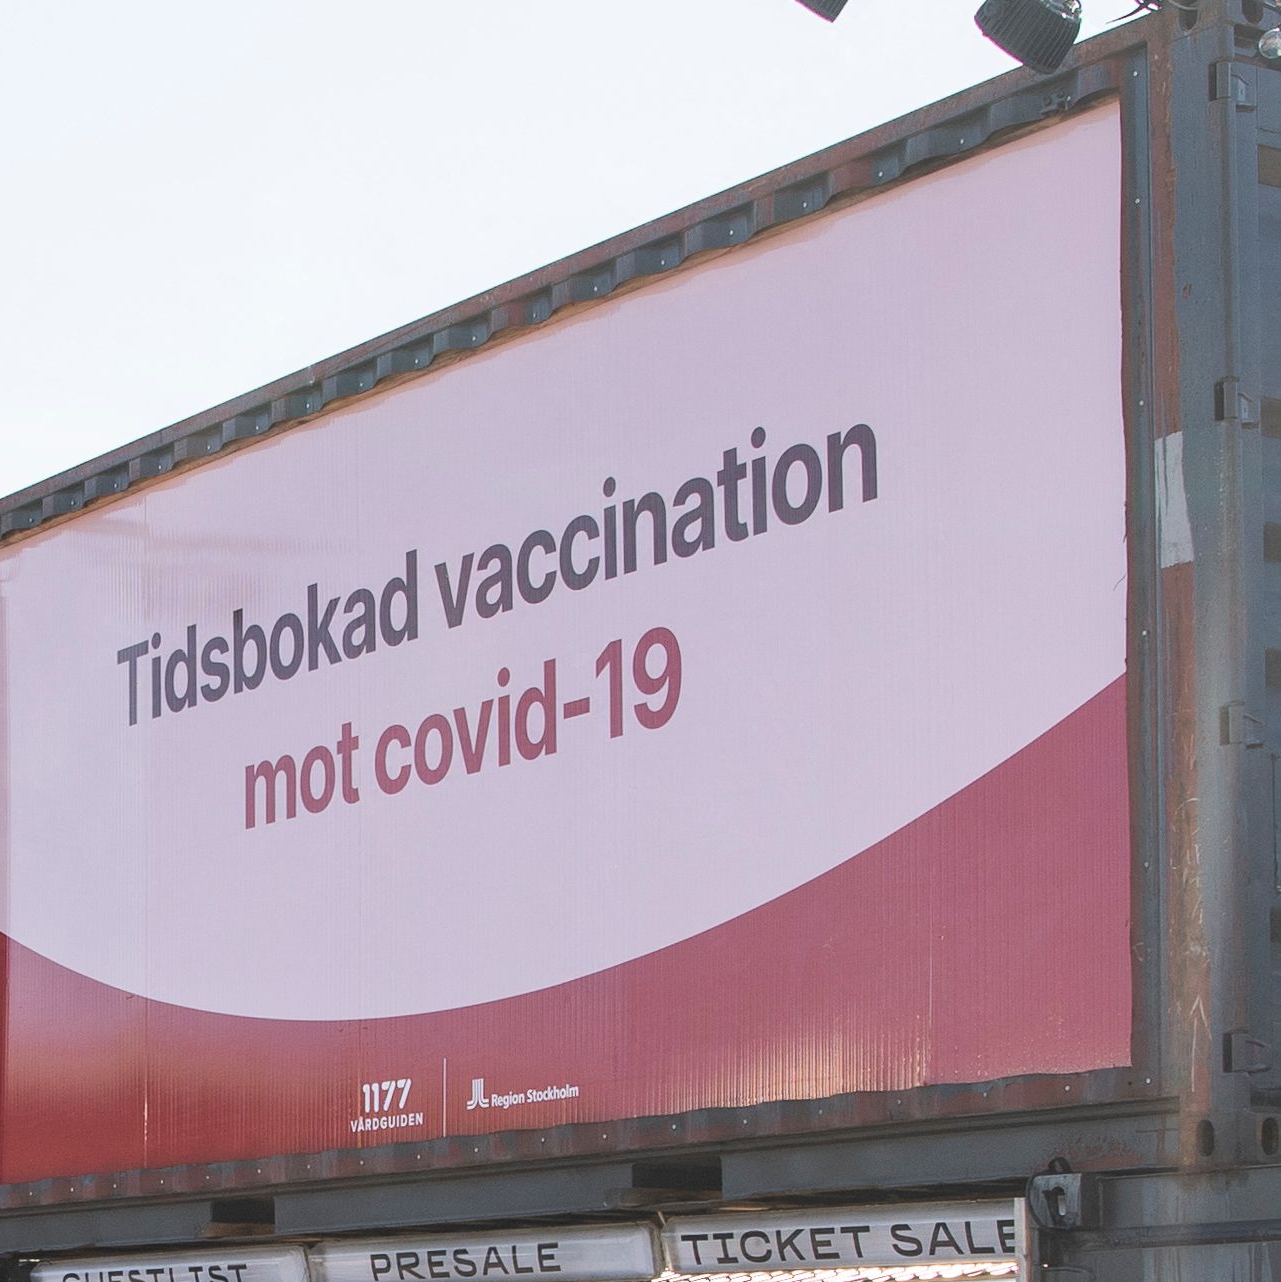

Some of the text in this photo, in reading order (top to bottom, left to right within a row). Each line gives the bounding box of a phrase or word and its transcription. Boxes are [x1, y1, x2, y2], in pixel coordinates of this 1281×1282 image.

[117, 423, 878, 726] Tidsbokad vaccination
[244, 626, 683, 830] mot covid-19
[362, 1078, 412, 1113] 1177
[491, 1083, 579, 1110] Region Stockholm
[350, 1112, 424, 1133] VÅRDGUIDEN
[369, 1241, 562, 1282] PRESALE
[680, 1218, 1015, 1266] TICKET SALE
